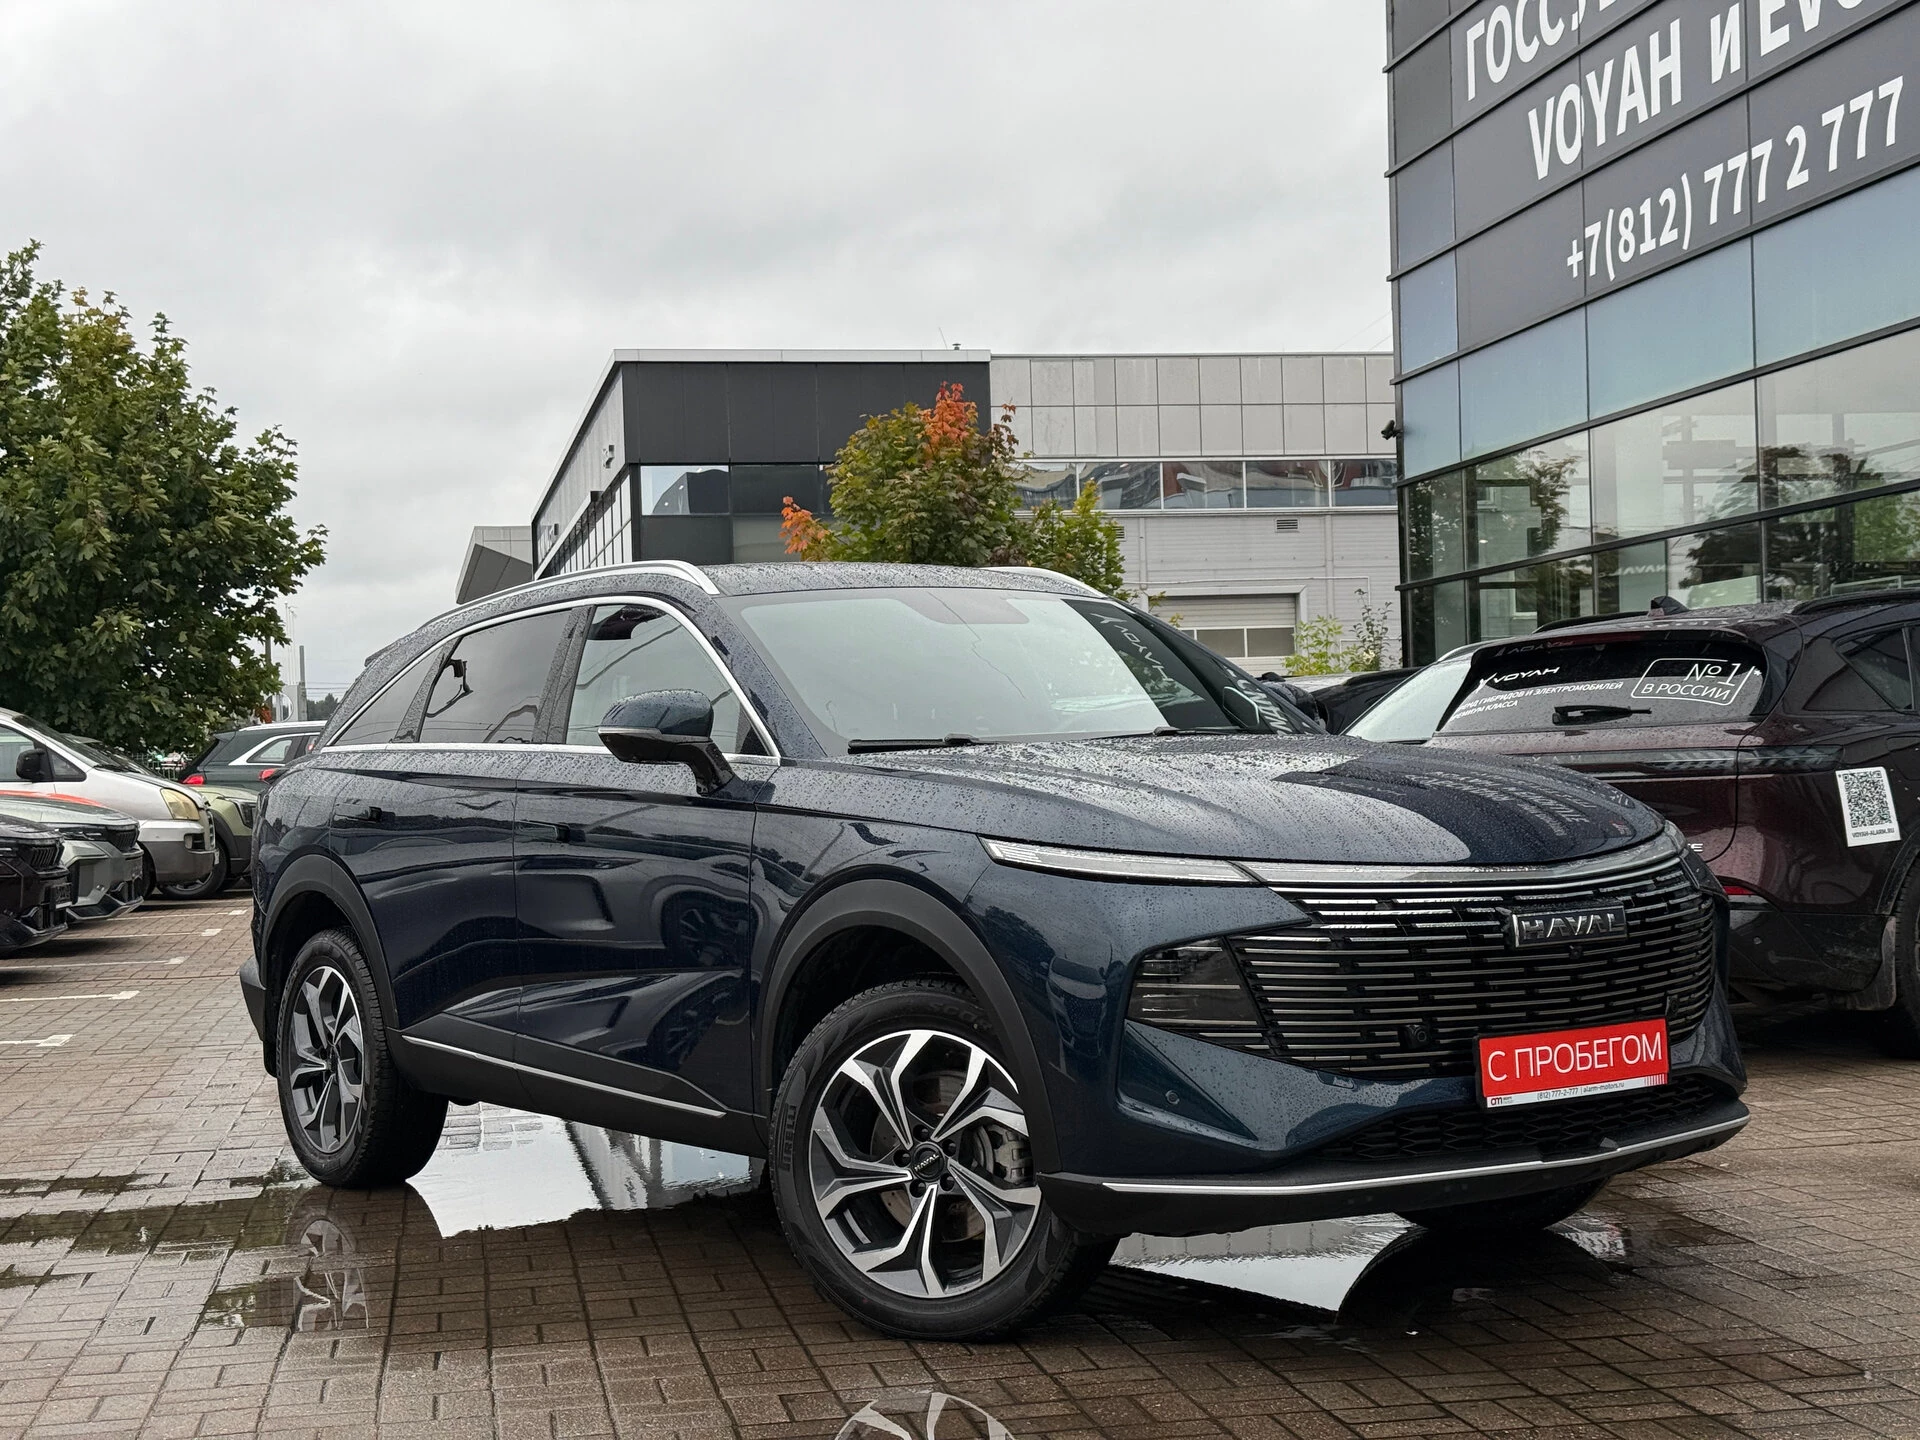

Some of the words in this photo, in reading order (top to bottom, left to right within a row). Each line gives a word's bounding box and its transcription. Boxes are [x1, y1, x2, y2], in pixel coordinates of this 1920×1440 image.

[1528, 18, 1682, 181] VOYAH
[1710, 3, 1742, 84] И
[1567, 173, 1692, 281] +7(812)
[1704, 139, 1774, 225] 777
[1786, 125, 1810, 190] 2
[1822, 75, 1904, 172] 777
[1494, 667, 1560, 684] VOYAH
[1479, 690, 1525, 705] ГИБРИДОВ
[1525, 689, 1534, 697] И
[1533, 682, 1624, 697] ЭЛЕКТРОМОБИЛЕЙ
[1641, 683, 1654, 694] В
[1656, 684, 1731, 701] РОССИИ
[1485, 700, 1518, 712] КЛАССА
[1520, 913, 1626, 940] HAVAL
[1487, 1050, 1508, 1082] С
[1515, 1032, 1663, 1079] ПРОБЕГОМ
[1551, 1087, 1579, 1098] 777-2-777
[1583, 1082, 1625, 1093] alarm-motors.ru
[914, 1153, 940, 1172] HAVAL
